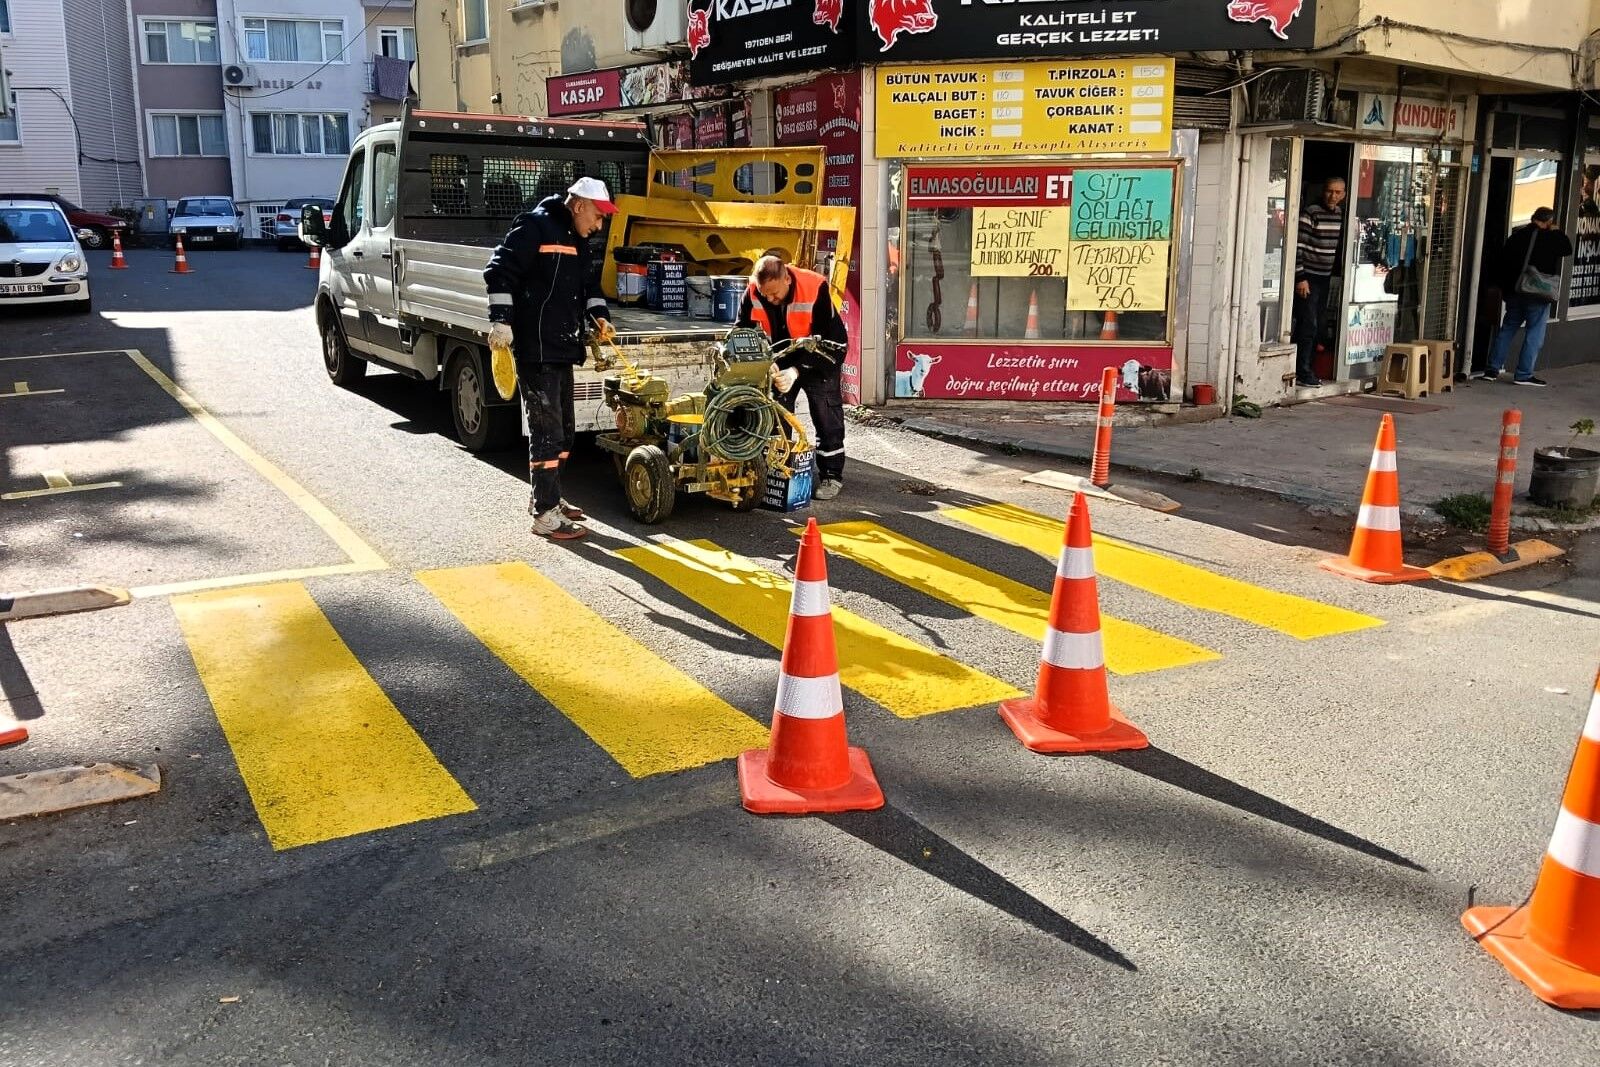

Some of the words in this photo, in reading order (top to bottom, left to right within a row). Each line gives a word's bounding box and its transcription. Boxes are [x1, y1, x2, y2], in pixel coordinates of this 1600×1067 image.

[716, 0, 792, 21] KAS
[1019, 9, 1106, 26] KALİTELİ
[1111, 11, 1137, 24] ET
[775, 31, 793, 43] BERİ
[996, 31, 1074, 47] GERÇEK
[1079, 29, 1160, 43] LEZZET!
[712, 57, 756, 72] DEĞİŞMEYEN
[758, 51, 784, 65] KALİTE
[785, 49, 797, 60] VE
[798, 44, 828, 57] LEZZET
[886, 73, 930, 85] BÜTÜN
[935, 73, 978, 83] TAVUK
[1048, 67, 1117, 80] T.PİRZOLA
[257, 78, 294, 89] İRLİK
[1035, 88, 1075, 98] TAVUK
[1080, 85, 1117, 97] CİĞER
[560, 86, 604, 105] KASAP
[892, 92, 947, 104] KALÇALI
[951, 91, 978, 101] BUT
[934, 109, 977, 119] BAGET
[1047, 105, 1115, 118] ÇORBALIK
[1395, 102, 1456, 132] KUNDURA
[940, 125, 977, 137] İNCİK
[1069, 123, 1114, 134] KANAT
[898, 143, 957, 152] Kaliteli
[910, 172, 1039, 194] ELMASOĞULLARI
[1080, 173, 1142, 201] SÜT
[975, 232, 987, 249] A
[971, 250, 1013, 265] JUMBO
[1015, 249, 1061, 264] KANAT
[1029, 263, 1053, 276] 200
[1096, 286, 1134, 309] 750
[987, 353, 1045, 369] Lezzetin
[1048, 358, 1078, 369] sırrı
[946, 375, 984, 396] doğru
[986, 376, 1039, 397] seçilmiş
[1042, 379, 1078, 392] etten
